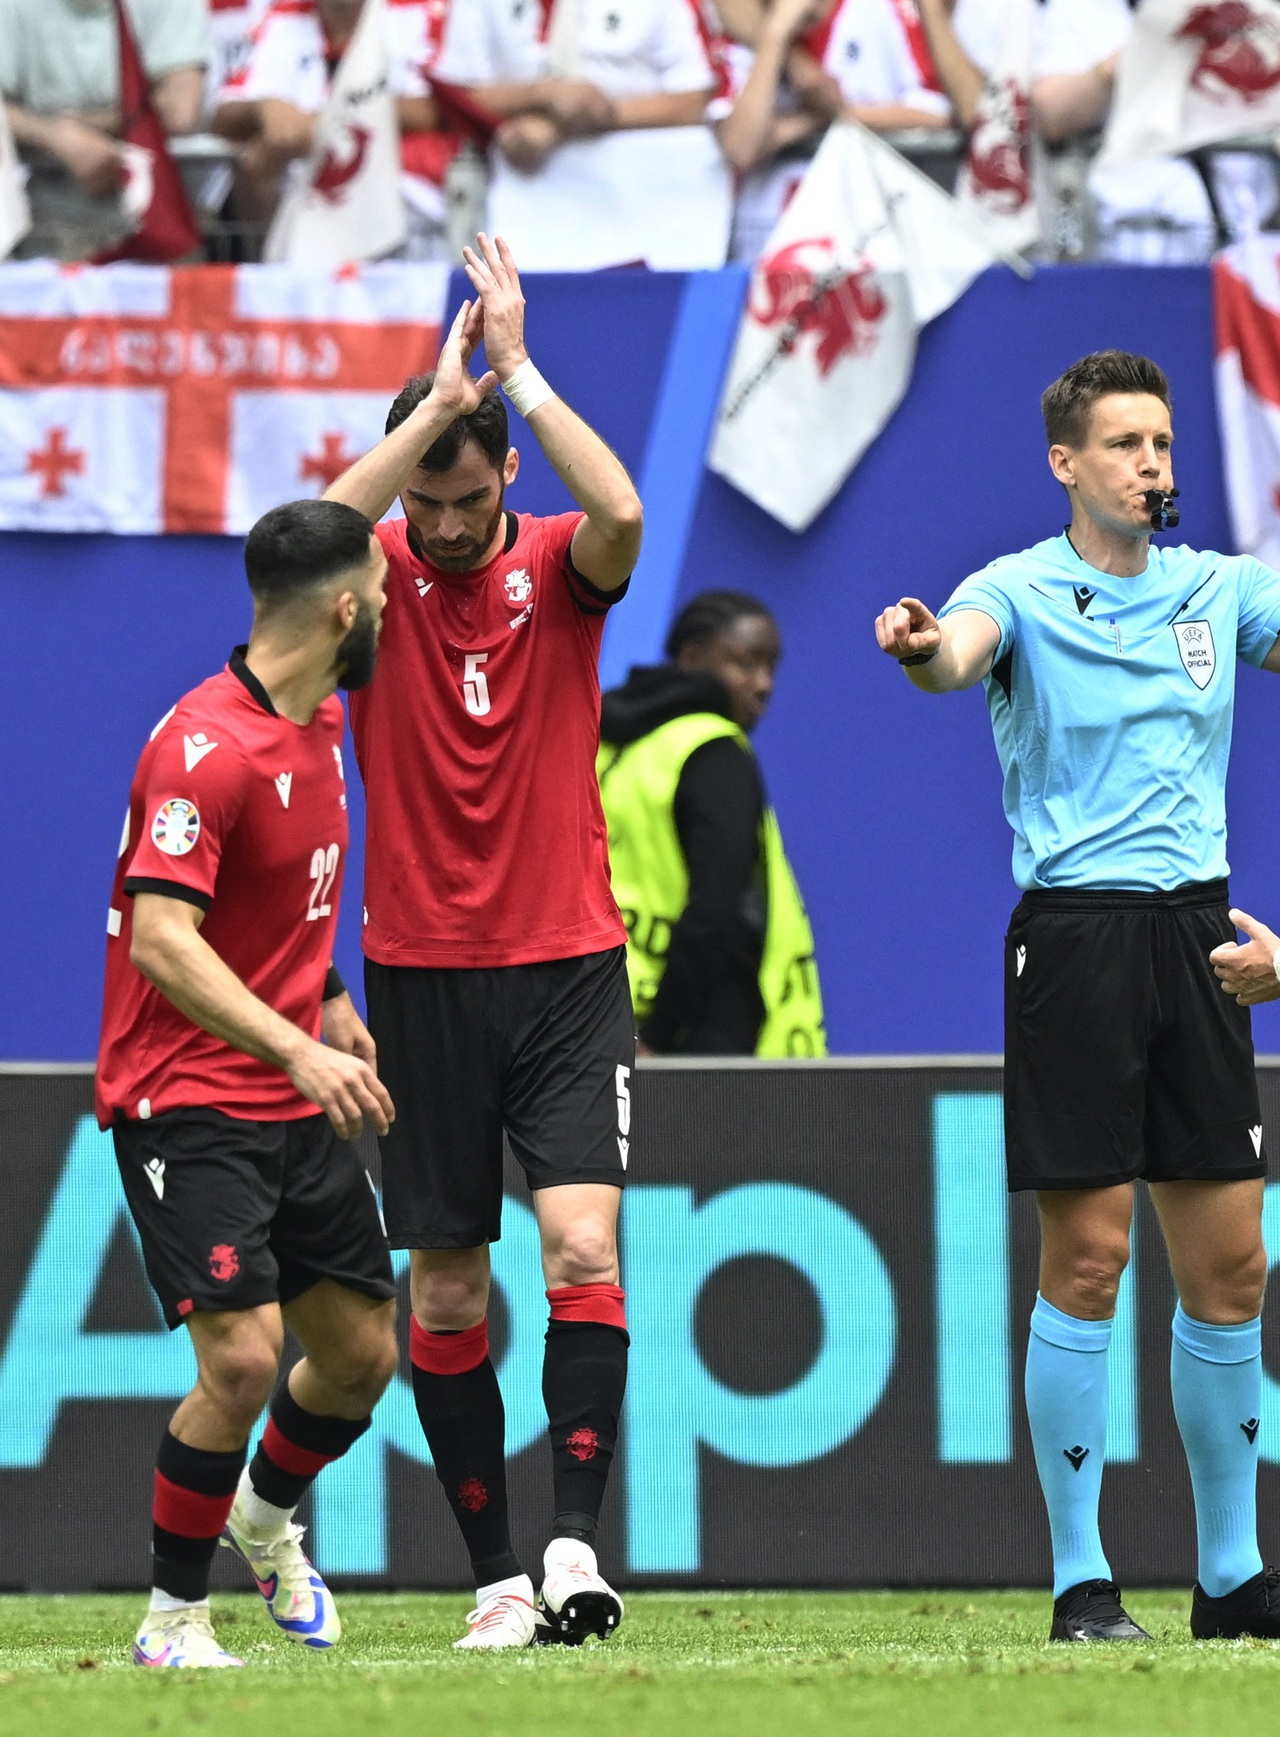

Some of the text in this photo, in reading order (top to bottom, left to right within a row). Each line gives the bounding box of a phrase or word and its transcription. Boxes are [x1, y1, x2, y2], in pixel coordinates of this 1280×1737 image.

[1183, 628, 1203, 641] UEFA
[1187, 649, 1207, 657] MATCH
[1187, 659, 1212, 668] OFFICIAL
[463, 652, 491, 717] 5
[306, 842, 341, 922] 22
[615, 1063, 631, 1136] 5
